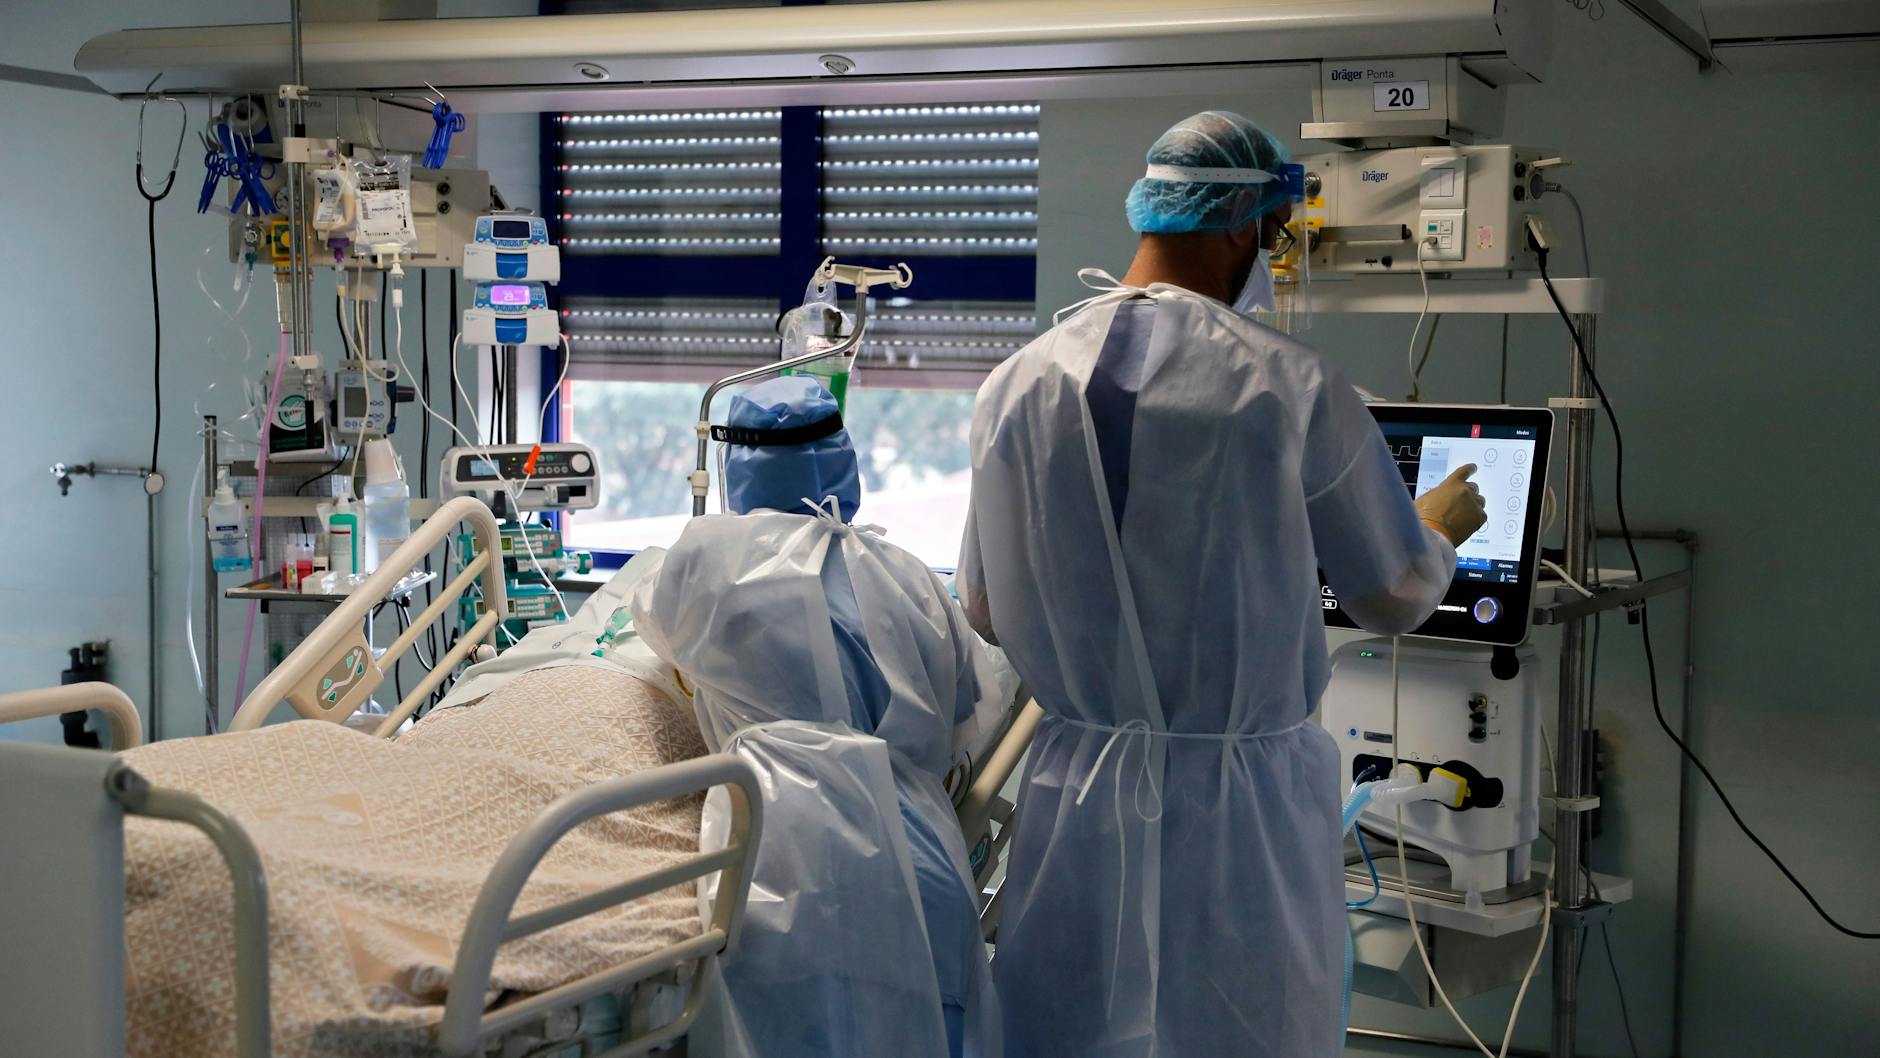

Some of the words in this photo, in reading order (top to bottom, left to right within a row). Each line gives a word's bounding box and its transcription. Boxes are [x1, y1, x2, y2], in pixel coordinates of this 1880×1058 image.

[1331, 69, 1362, 81] Dräger
[1367, 69, 1394, 79] Ponta
[1388, 87, 1414, 107] 20
[1362, 170, 1389, 183] Dräger
